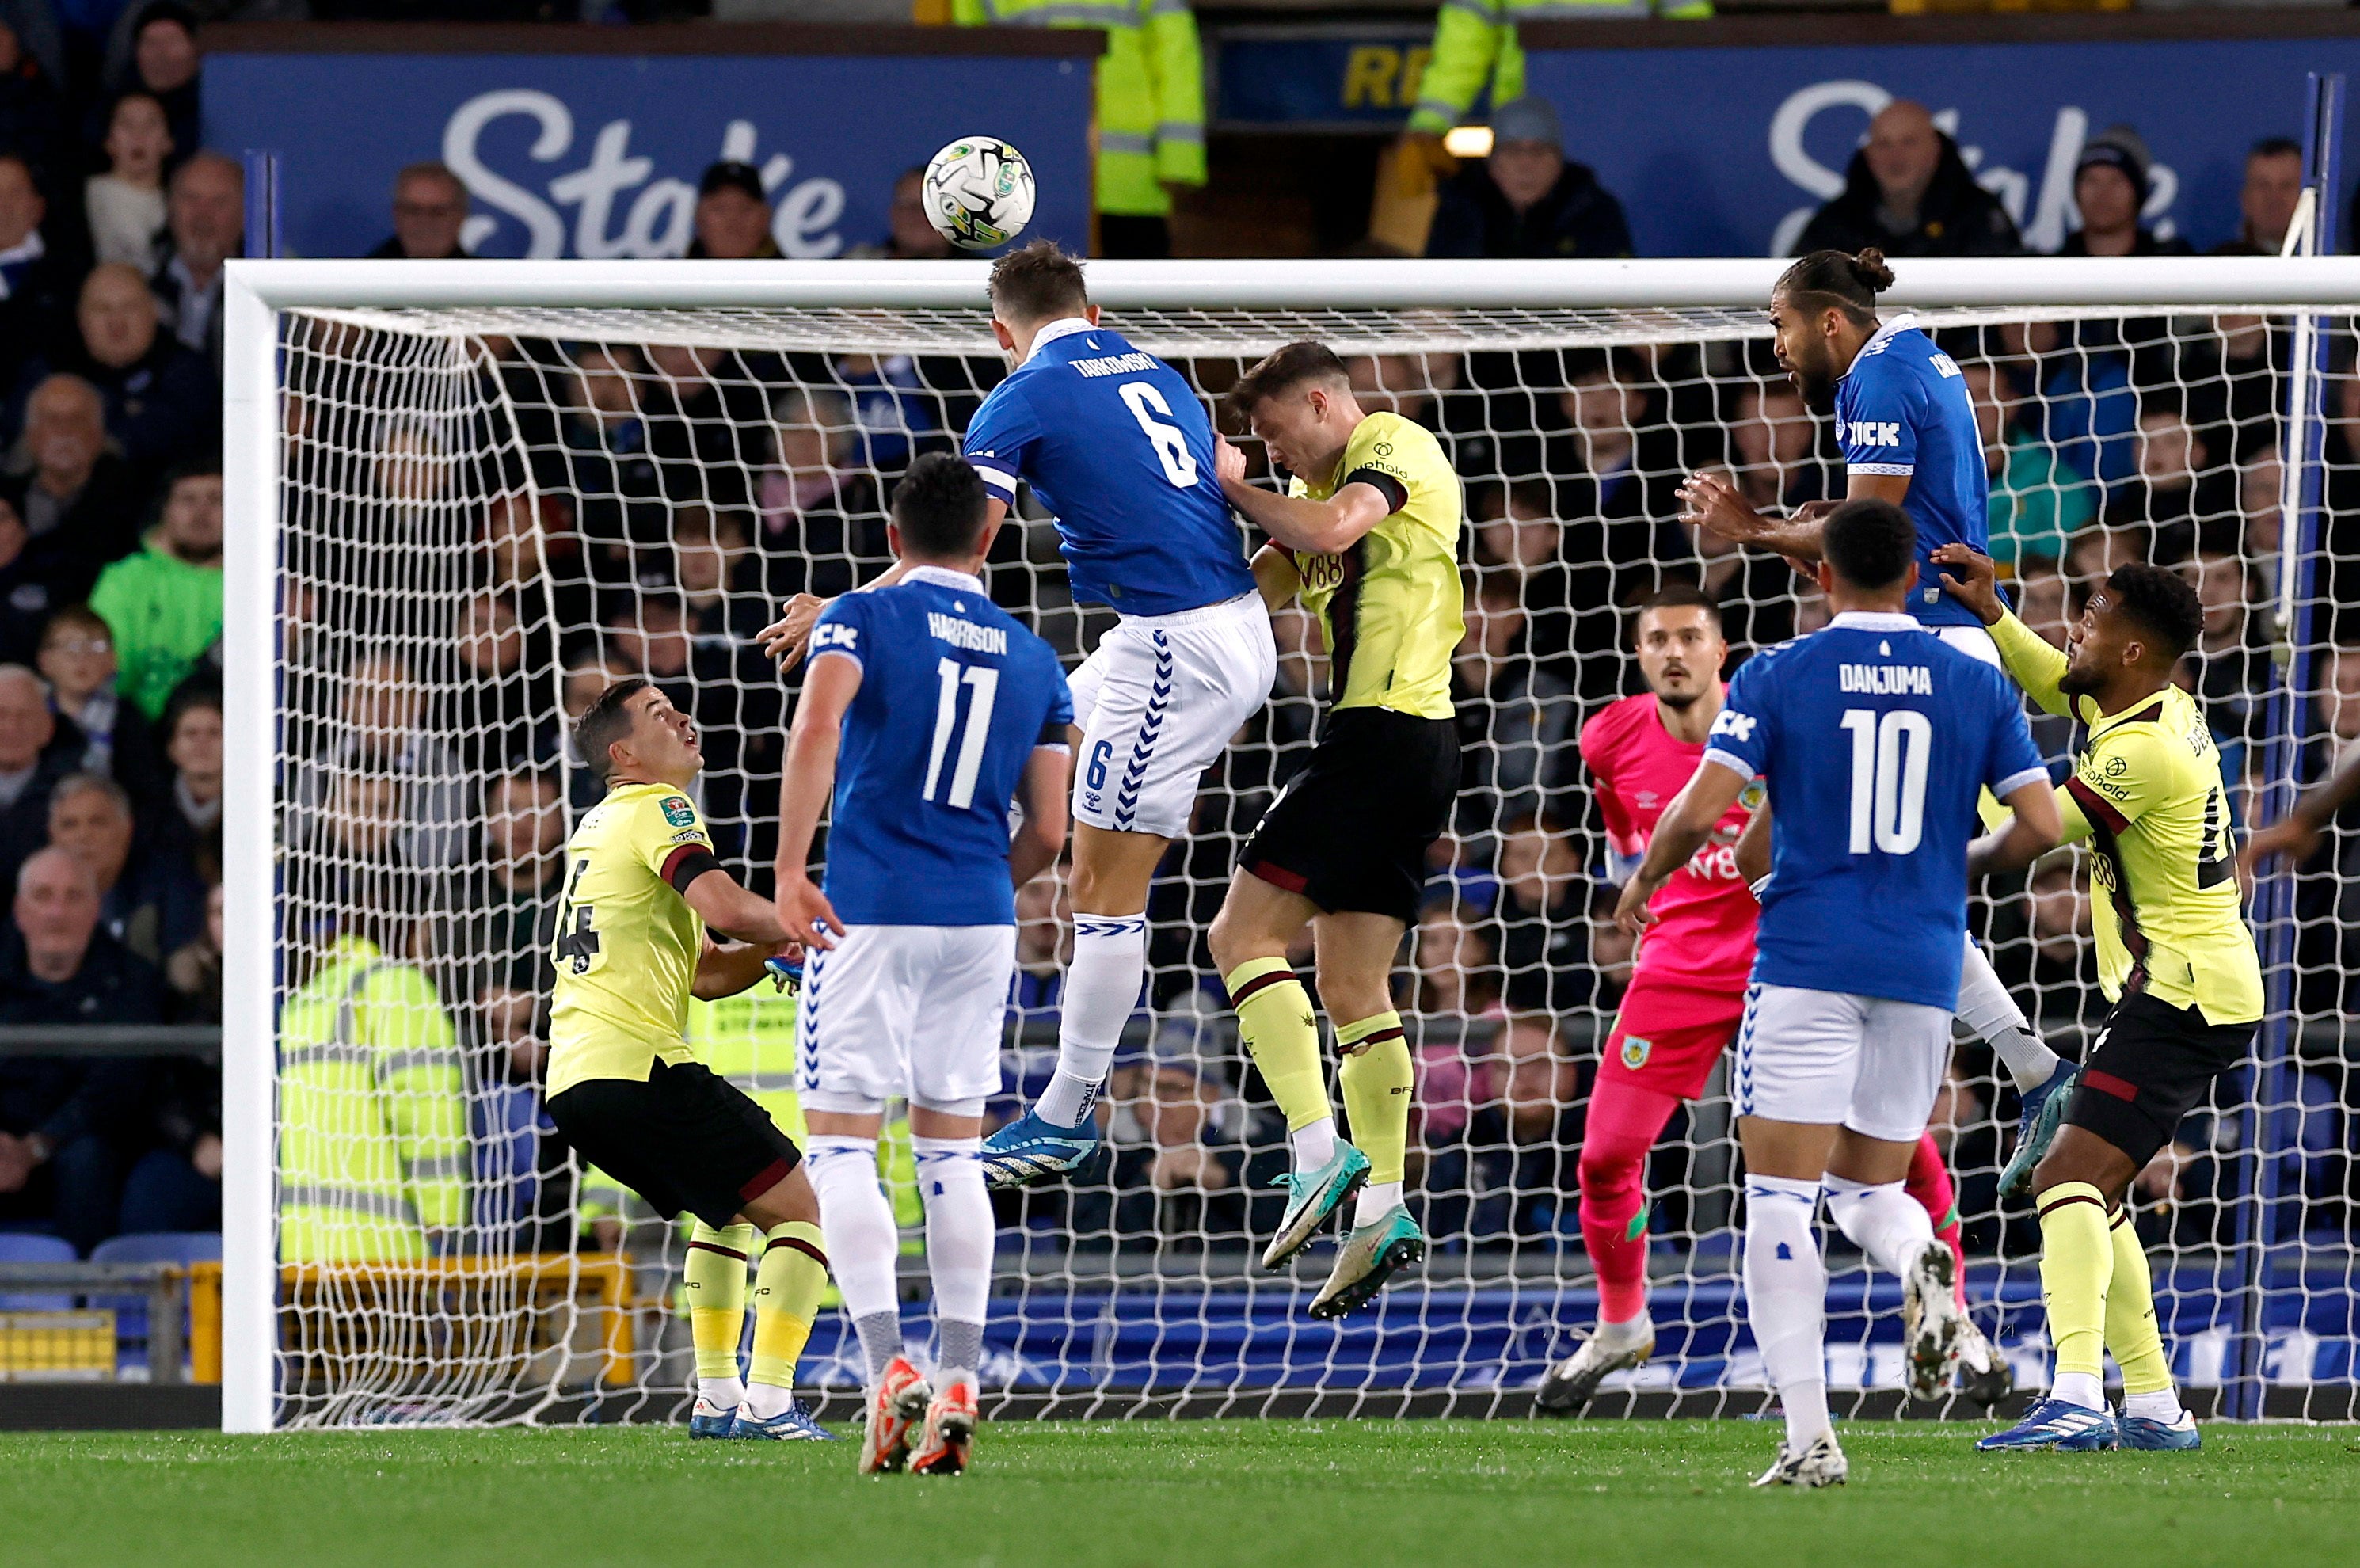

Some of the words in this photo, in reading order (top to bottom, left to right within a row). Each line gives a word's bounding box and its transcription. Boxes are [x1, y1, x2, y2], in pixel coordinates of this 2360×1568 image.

[1068, 352, 1159, 378] TARKOWSKI
[1118, 382, 1200, 489] 6
[927, 612, 1007, 656] HARRISON
[1839, 664, 1932, 695] DANJUMA
[923, 657, 999, 810] 11
[1087, 740, 1113, 790] 6
[1840, 709, 1932, 855] 10
